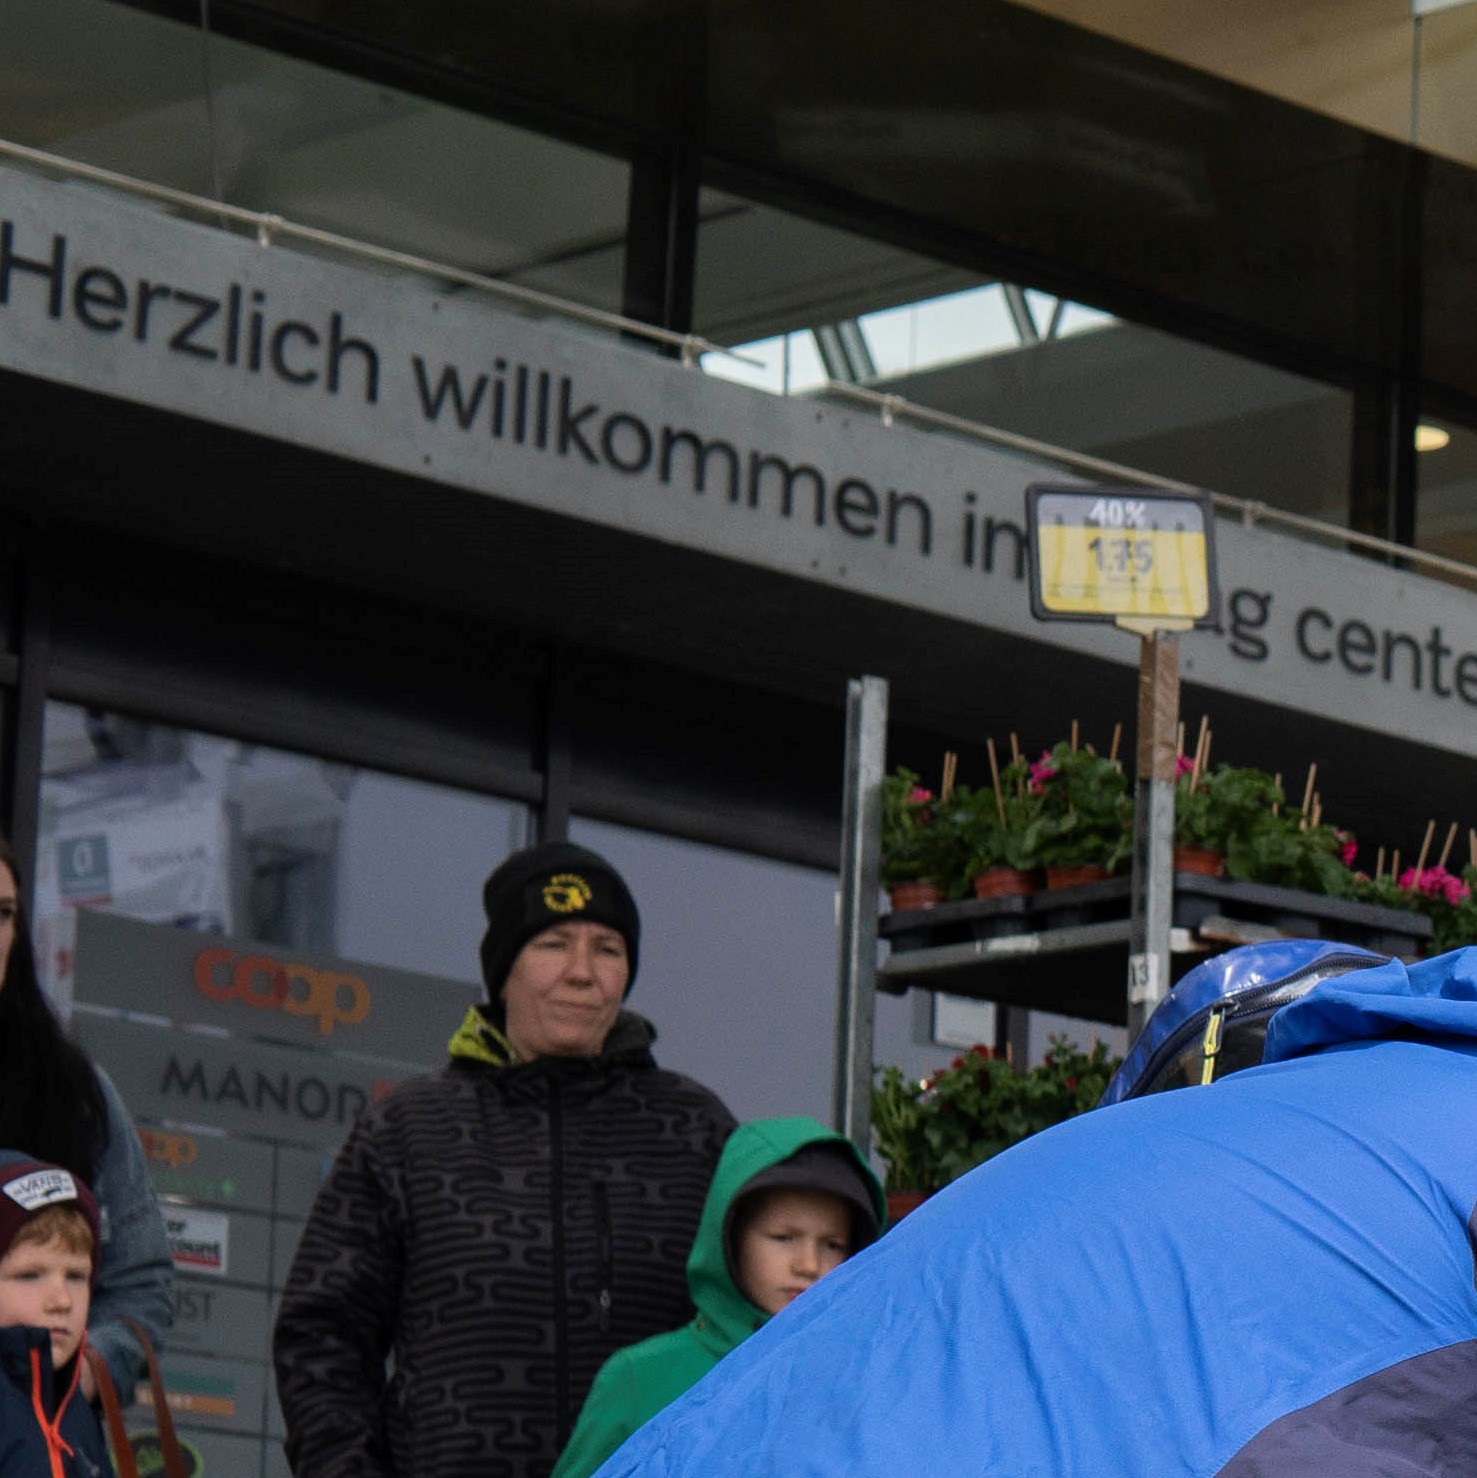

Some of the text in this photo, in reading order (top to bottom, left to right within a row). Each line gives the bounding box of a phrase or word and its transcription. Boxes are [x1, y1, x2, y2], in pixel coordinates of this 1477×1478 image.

[0, 220, 381, 404] Herzlich
[411, 353, 933, 556] willkommen
[1088, 498, 1147, 527] 40%
[193, 945, 372, 1037] coop
